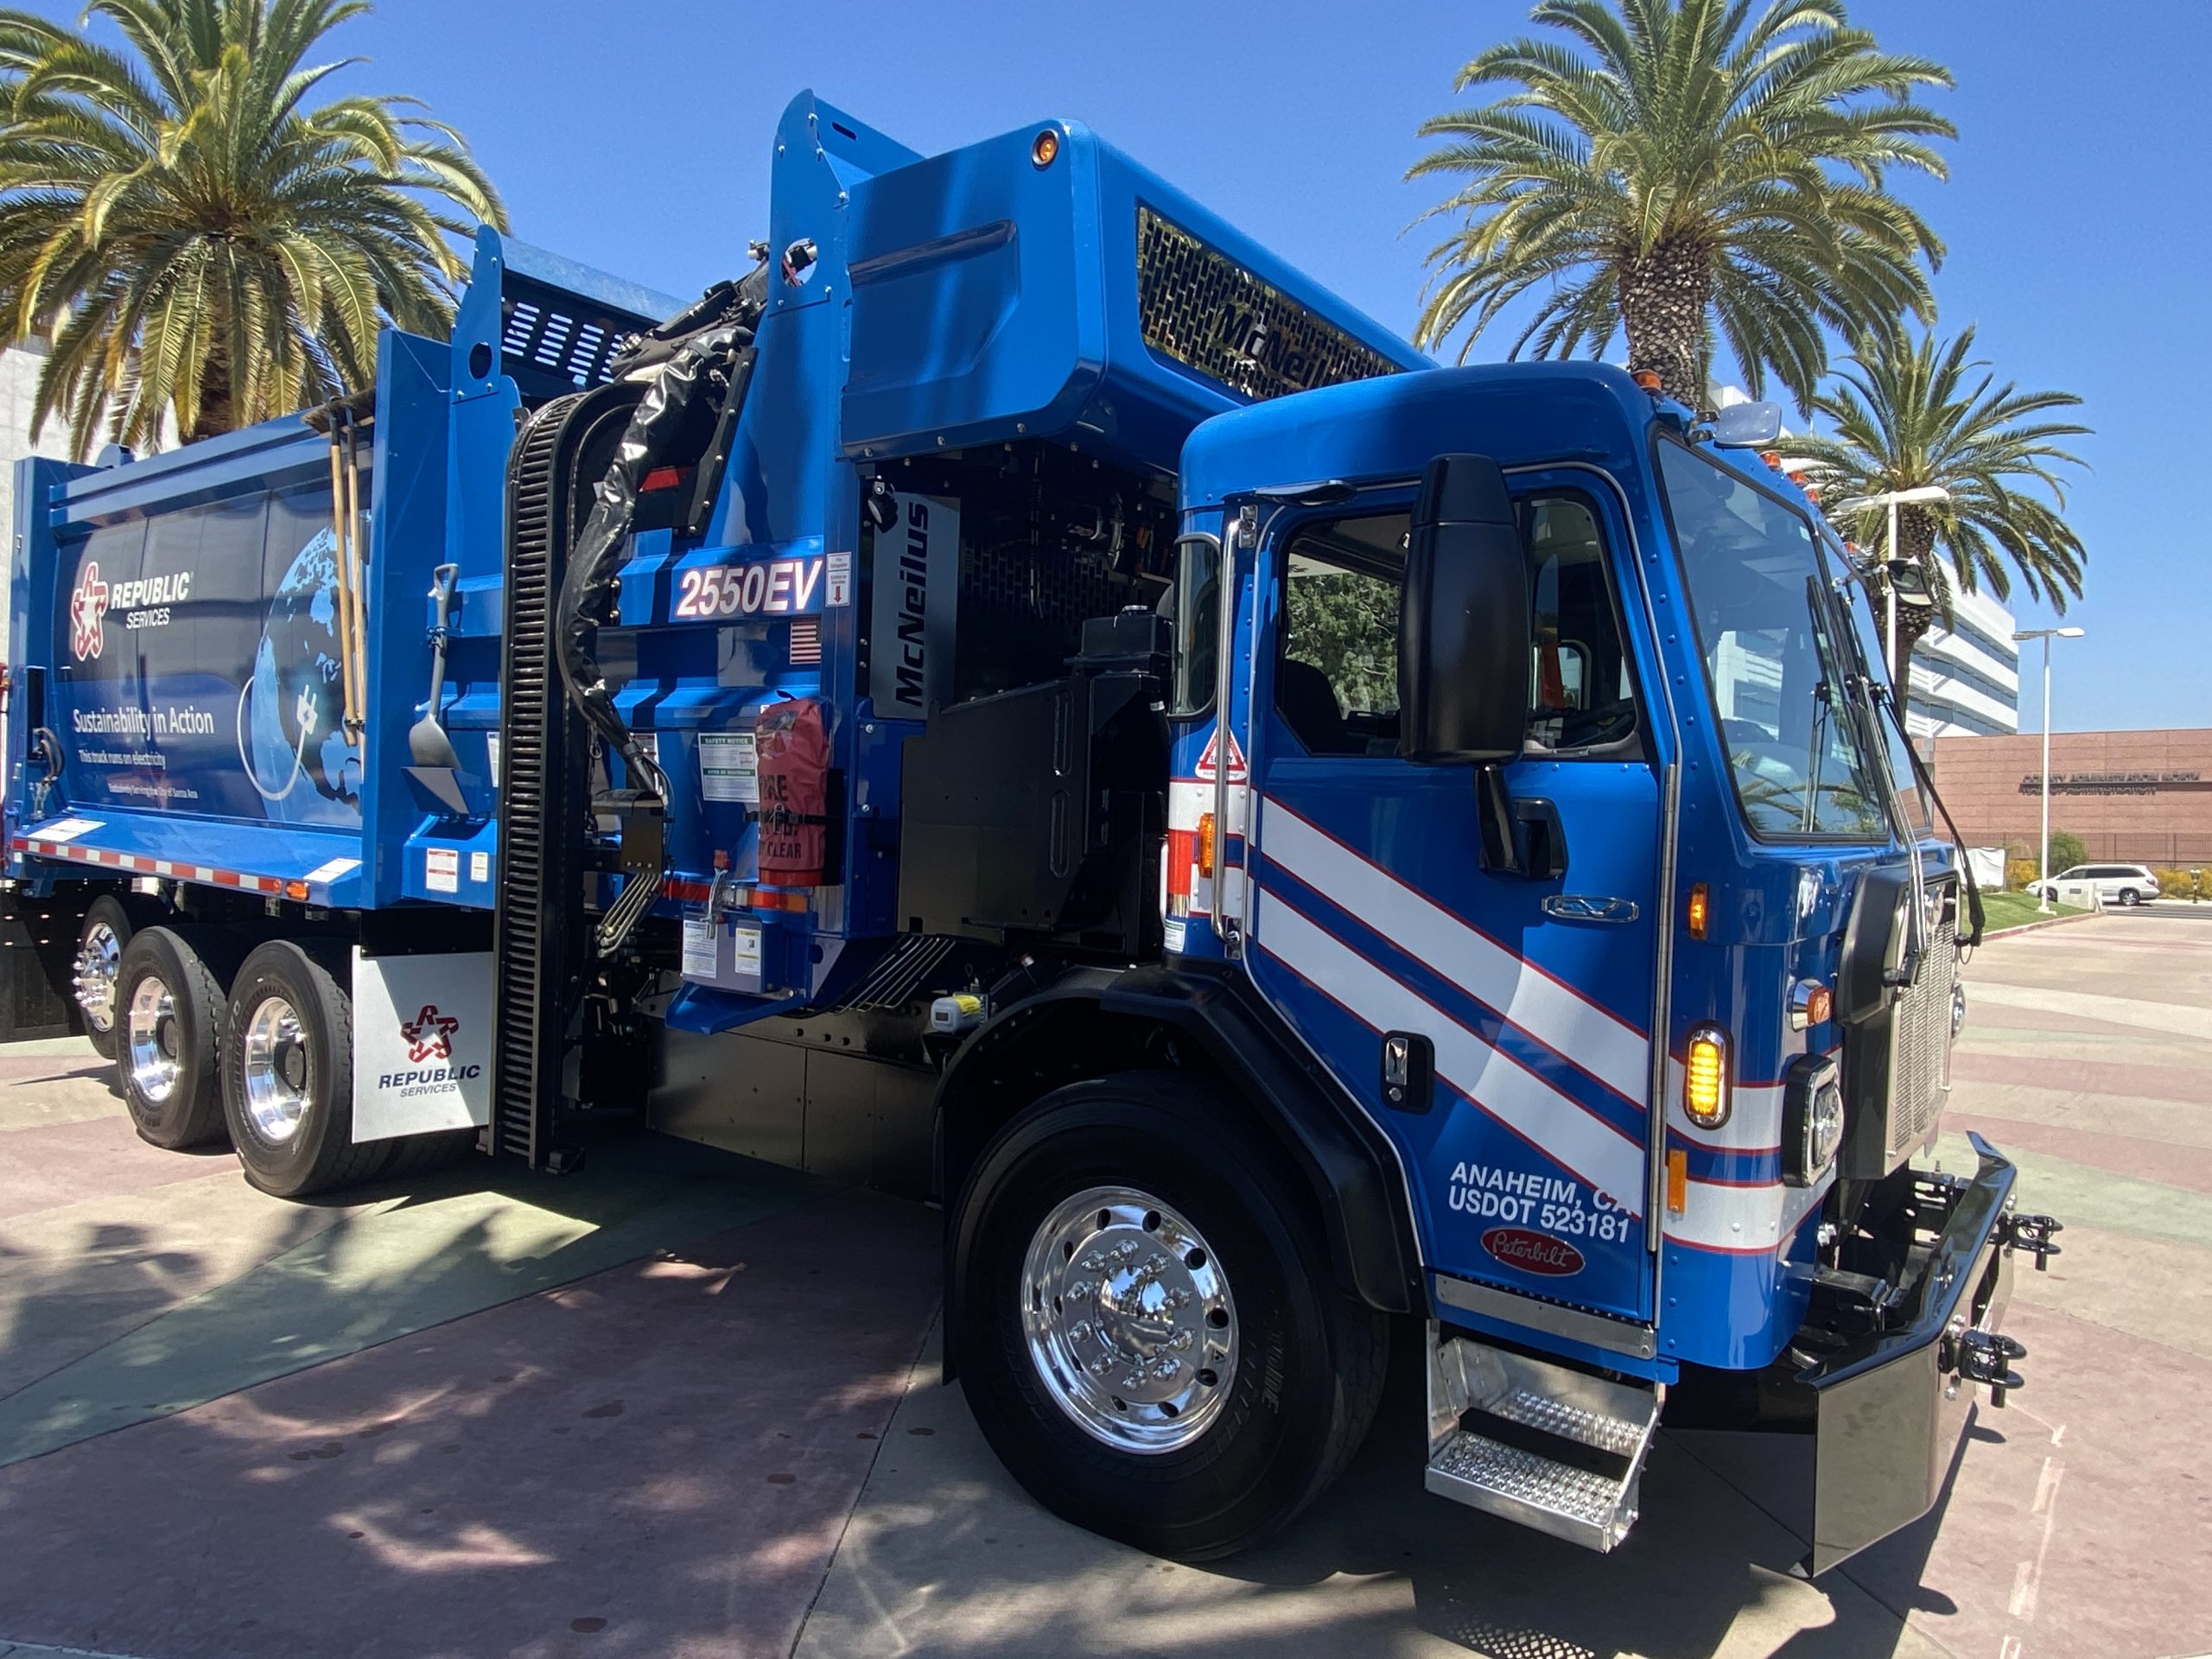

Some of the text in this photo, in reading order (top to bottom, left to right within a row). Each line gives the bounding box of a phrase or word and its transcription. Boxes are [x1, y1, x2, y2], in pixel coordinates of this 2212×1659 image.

[1214, 302, 1333, 388] McNeil
[111, 571, 191, 610] REPUBLIC
[677, 560, 823, 615] 2550EV
[895, 502, 929, 707] McNeilus
[125, 607, 171, 629] SERVICES
[73, 705, 214, 741] Sustainability in Action
[132, 750, 166, 770] electricity
[760, 774, 789, 801] RE
[767, 841, 802, 859] CLEAR
[378, 1065, 480, 1089] REPUBLIC
[400, 1083, 456, 1097] SERVICES
[1450, 1161, 1581, 1210] ANAHEIM,
[1448, 1185, 1630, 1243] USDOT 523181
[1492, 1231, 1576, 1268] Peterbilt
